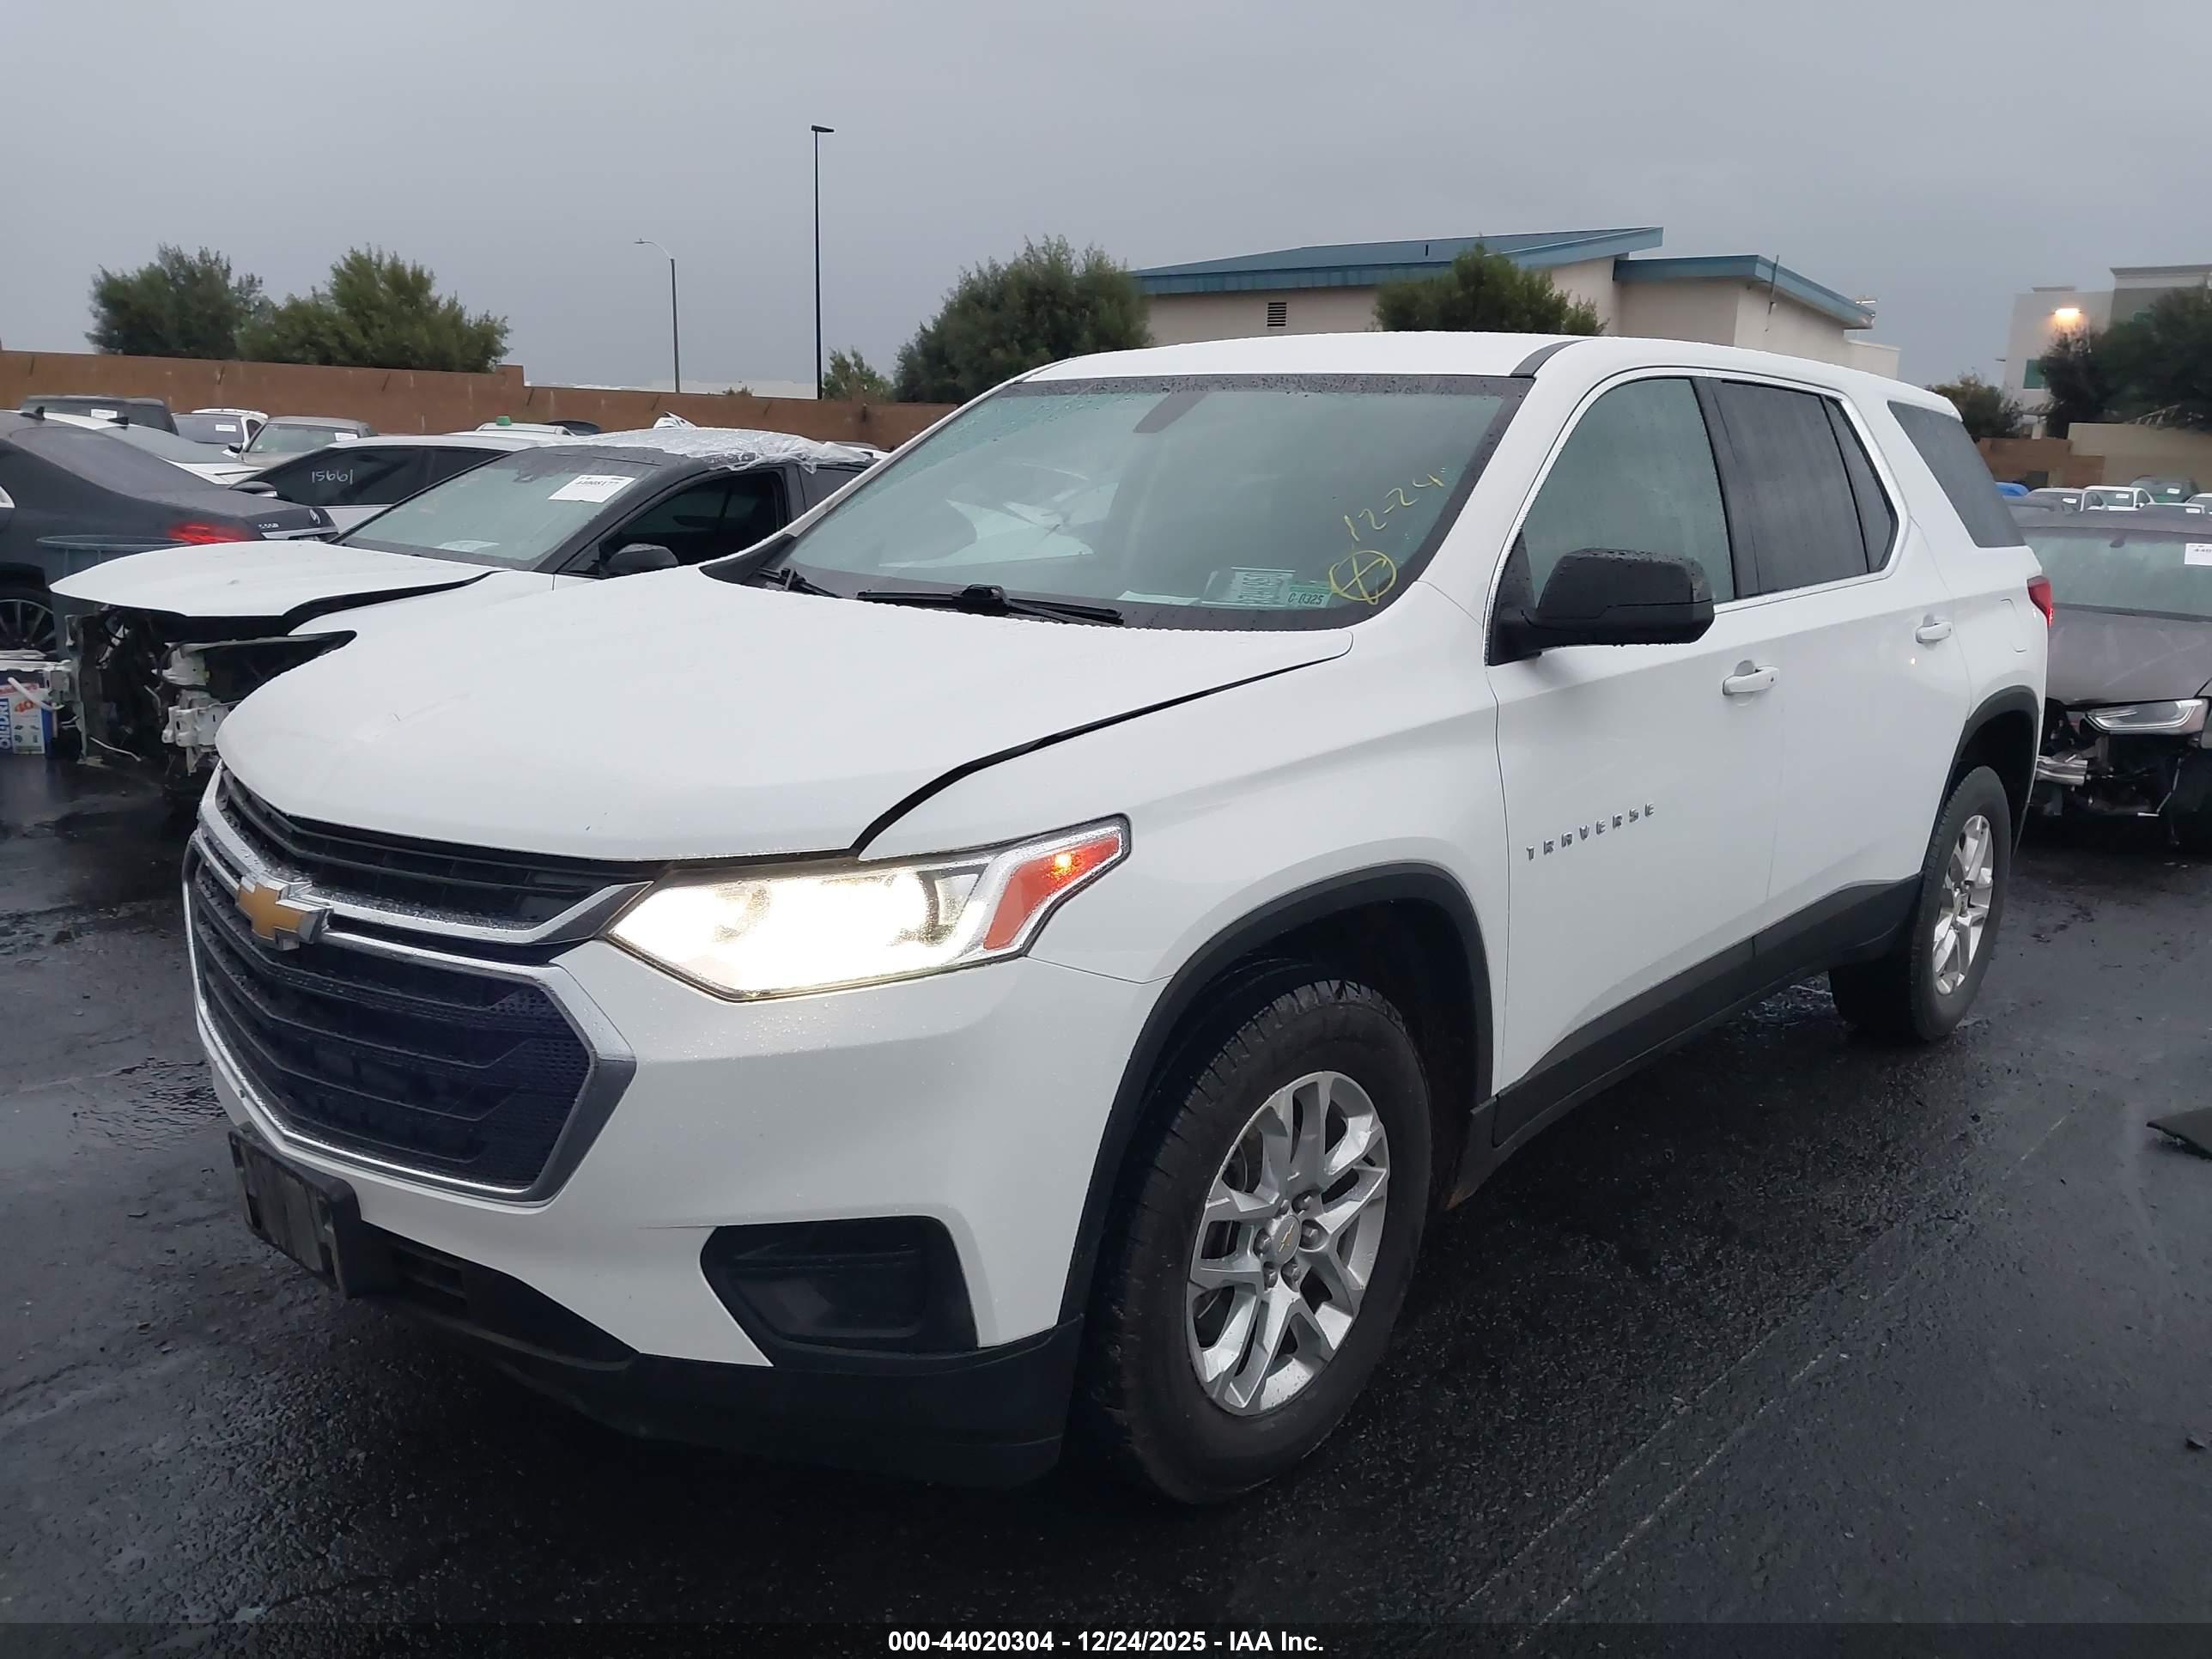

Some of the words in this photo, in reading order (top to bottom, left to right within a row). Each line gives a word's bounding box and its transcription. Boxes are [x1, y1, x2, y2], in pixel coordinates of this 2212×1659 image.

[312, 469, 353, 485] 15661
[1343, 473, 1444, 542] 12-24
[1526, 803, 1655, 861] TRAVERSE
